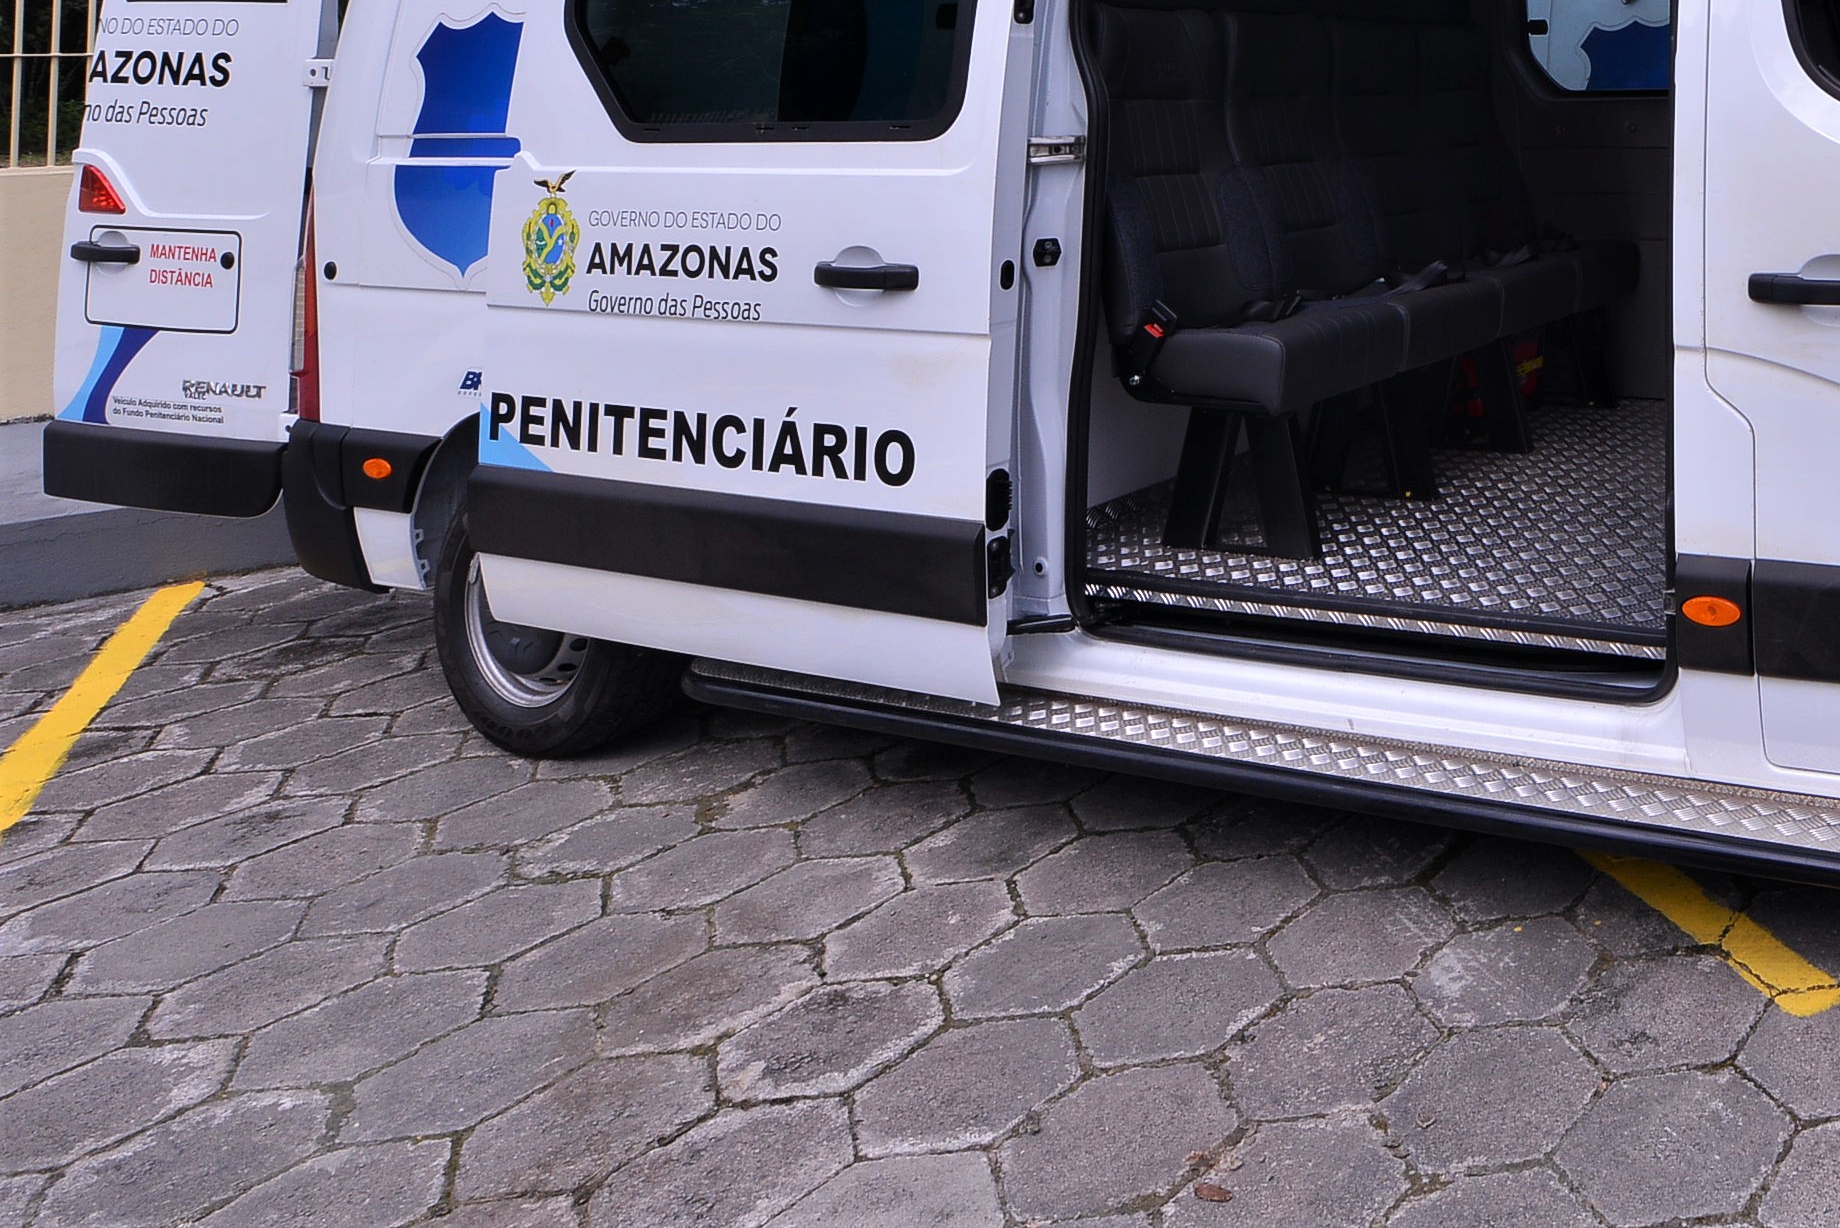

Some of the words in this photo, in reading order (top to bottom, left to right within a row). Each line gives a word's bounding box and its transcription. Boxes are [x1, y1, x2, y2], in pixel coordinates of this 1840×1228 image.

[121, 18, 144, 35] DO
[147, 18, 208, 36] ESTADO
[212, 19, 239, 36] DO
[88, 50, 233, 88] AZONAS
[105, 99, 134, 124] das
[136, 100, 208, 127] Pessoas
[588, 210, 660, 229] GOVERNO
[664, 211, 687, 229] DO
[691, 212, 752, 230] ESTADO
[756, 214, 782, 232] DO
[150, 244, 217, 263] MANTENHA
[586, 241, 779, 283] AMAZONAS
[150, 267, 213, 288] DISTÂNCIA
[588, 289, 653, 316] Governo
[658, 292, 687, 317] das
[692, 294, 761, 321] Pessoas
[182, 379, 266, 399] RENAULT
[123, 407, 144, 417] Fundo
[192, 414, 224, 424] Nacional
[138, 398, 172, 410] Adquirido
[173, 403, 188, 411] com
[190, 404, 222, 414] recursos
[487, 391, 916, 487] PENITENCIÁRIO
